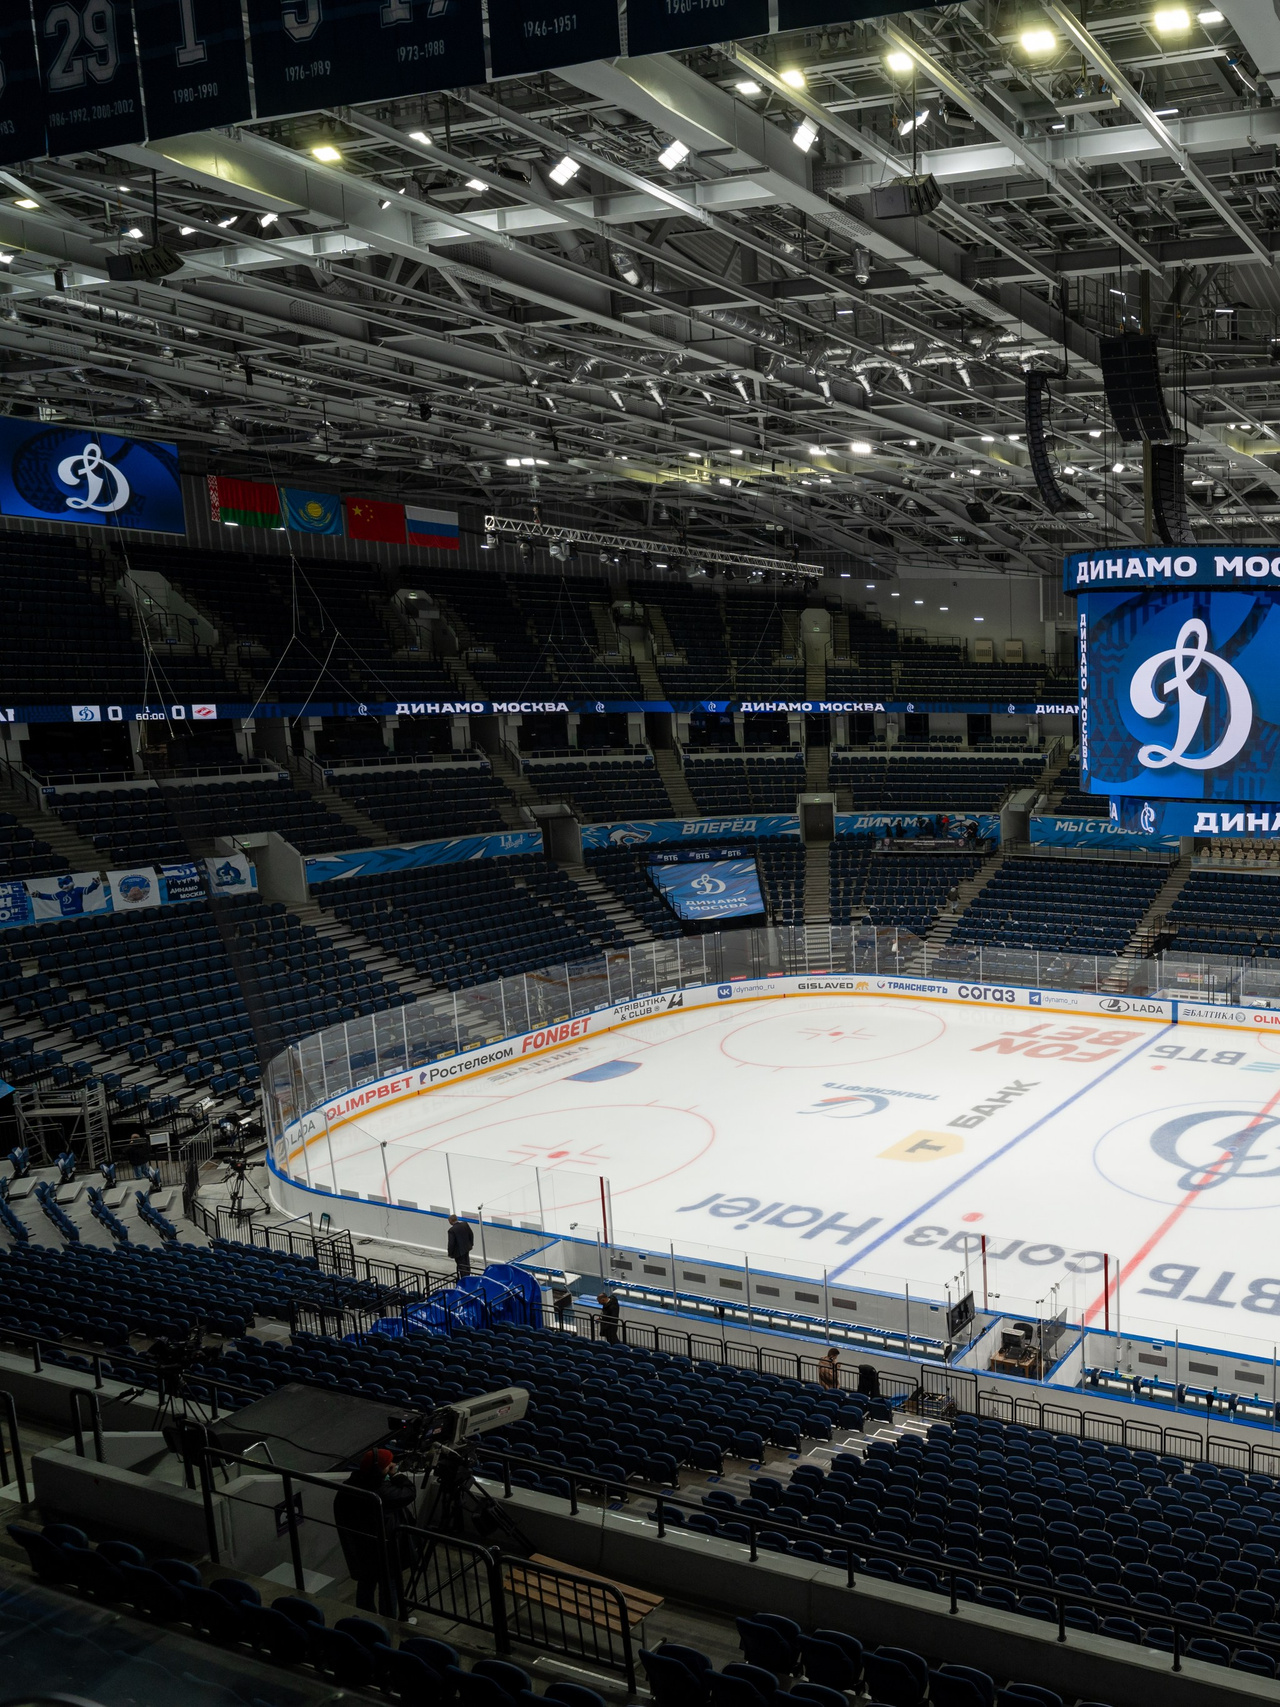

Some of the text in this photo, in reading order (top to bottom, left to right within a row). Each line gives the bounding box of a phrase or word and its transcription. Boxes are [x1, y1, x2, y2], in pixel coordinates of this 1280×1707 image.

[523, 14, 577, 38] 1946-1951
[45, 0, 120, 92] 29
[396, 40, 445, 62] 1973-1988
[285, 60, 331, 82] 1976-1989
[173, 83, 218, 104] 1980-1990
[1077, 556, 1198, 583] ДИНАМО
[107, 706, 122, 721] 0
[171, 705, 185, 720] 0
[395, 702, 569, 715] ДИНАМО МОСКВА
[740, 702, 885, 712] ДИНАМО МОСКВА
[1035, 704, 1079, 714] ДИНА
[1081, 697, 1089, 771] МОСКВА
[681, 819, 757, 835] ВПЕРЁД
[1055, 821, 1084, 832] МЫ
[685, 897, 747, 906] ДИНАМО
[689, 902, 748, 911] МОСКВА
[798, 982, 854, 990] GISLAVED
[887, 981, 948, 994] ТРАНСНЕФТЬ
[613, 995, 666, 1016] ATRIBUTIKA
[628, 1006, 652, 1019] CLUB
[1132, 1003, 1164, 1014] LADA
[1190, 1009, 1234, 1020] БАЛТИКА
[521, 1017, 591, 1053] FONBET
[1001, 1023, 1146, 1048] BET
[970, 1037, 1121, 1063] FON
[1149, 1044, 1248, 1066] ВТБ
[429, 1046, 514, 1082] Ростелеком
[326, 1075, 413, 1121] OLIMPBET
[822, 1082, 941, 1101] ТРАНСНЕФТЬ
[946, 1079, 1041, 1130] БАНК
[674, 1192, 884, 1246] Haier
